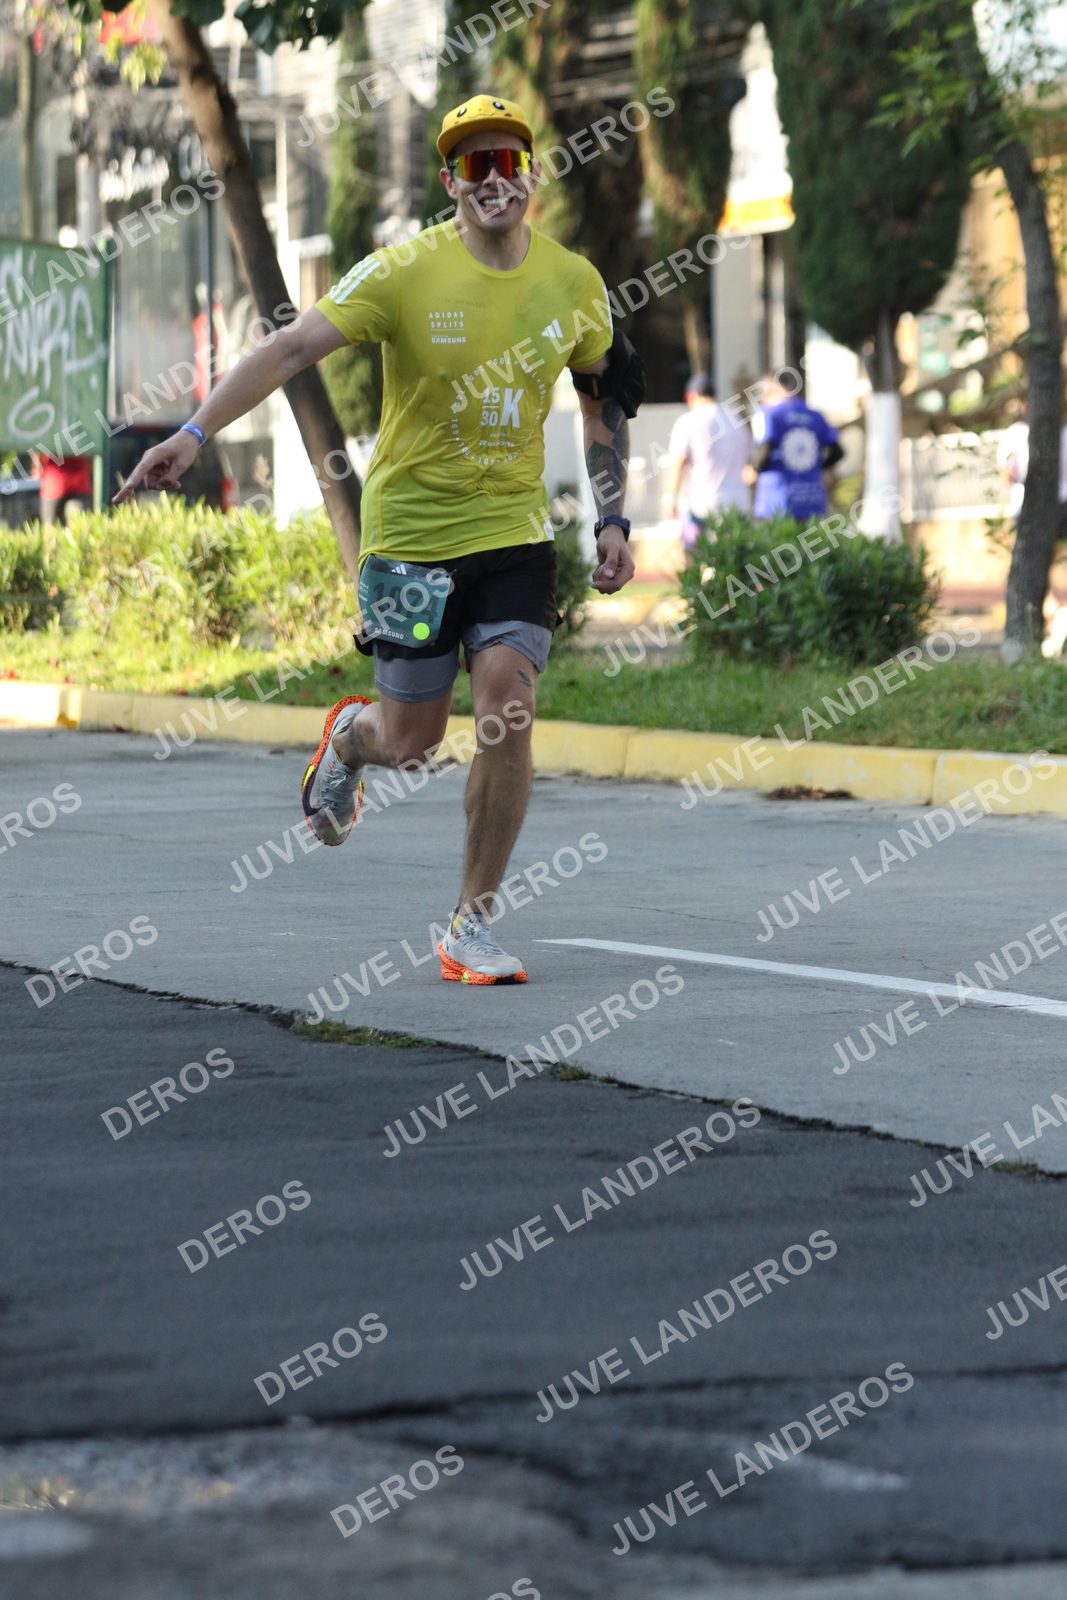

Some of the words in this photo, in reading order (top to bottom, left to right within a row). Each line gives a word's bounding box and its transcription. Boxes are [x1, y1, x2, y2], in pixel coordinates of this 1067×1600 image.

[428, 311, 464, 319] ADIDAS
[431, 320, 464, 328] SPLITS
[431, 336, 467, 344] SAMSUNG
[483, 386, 499, 404] 15
[501, 388, 524, 429] K
[480, 410, 498, 426] 30
